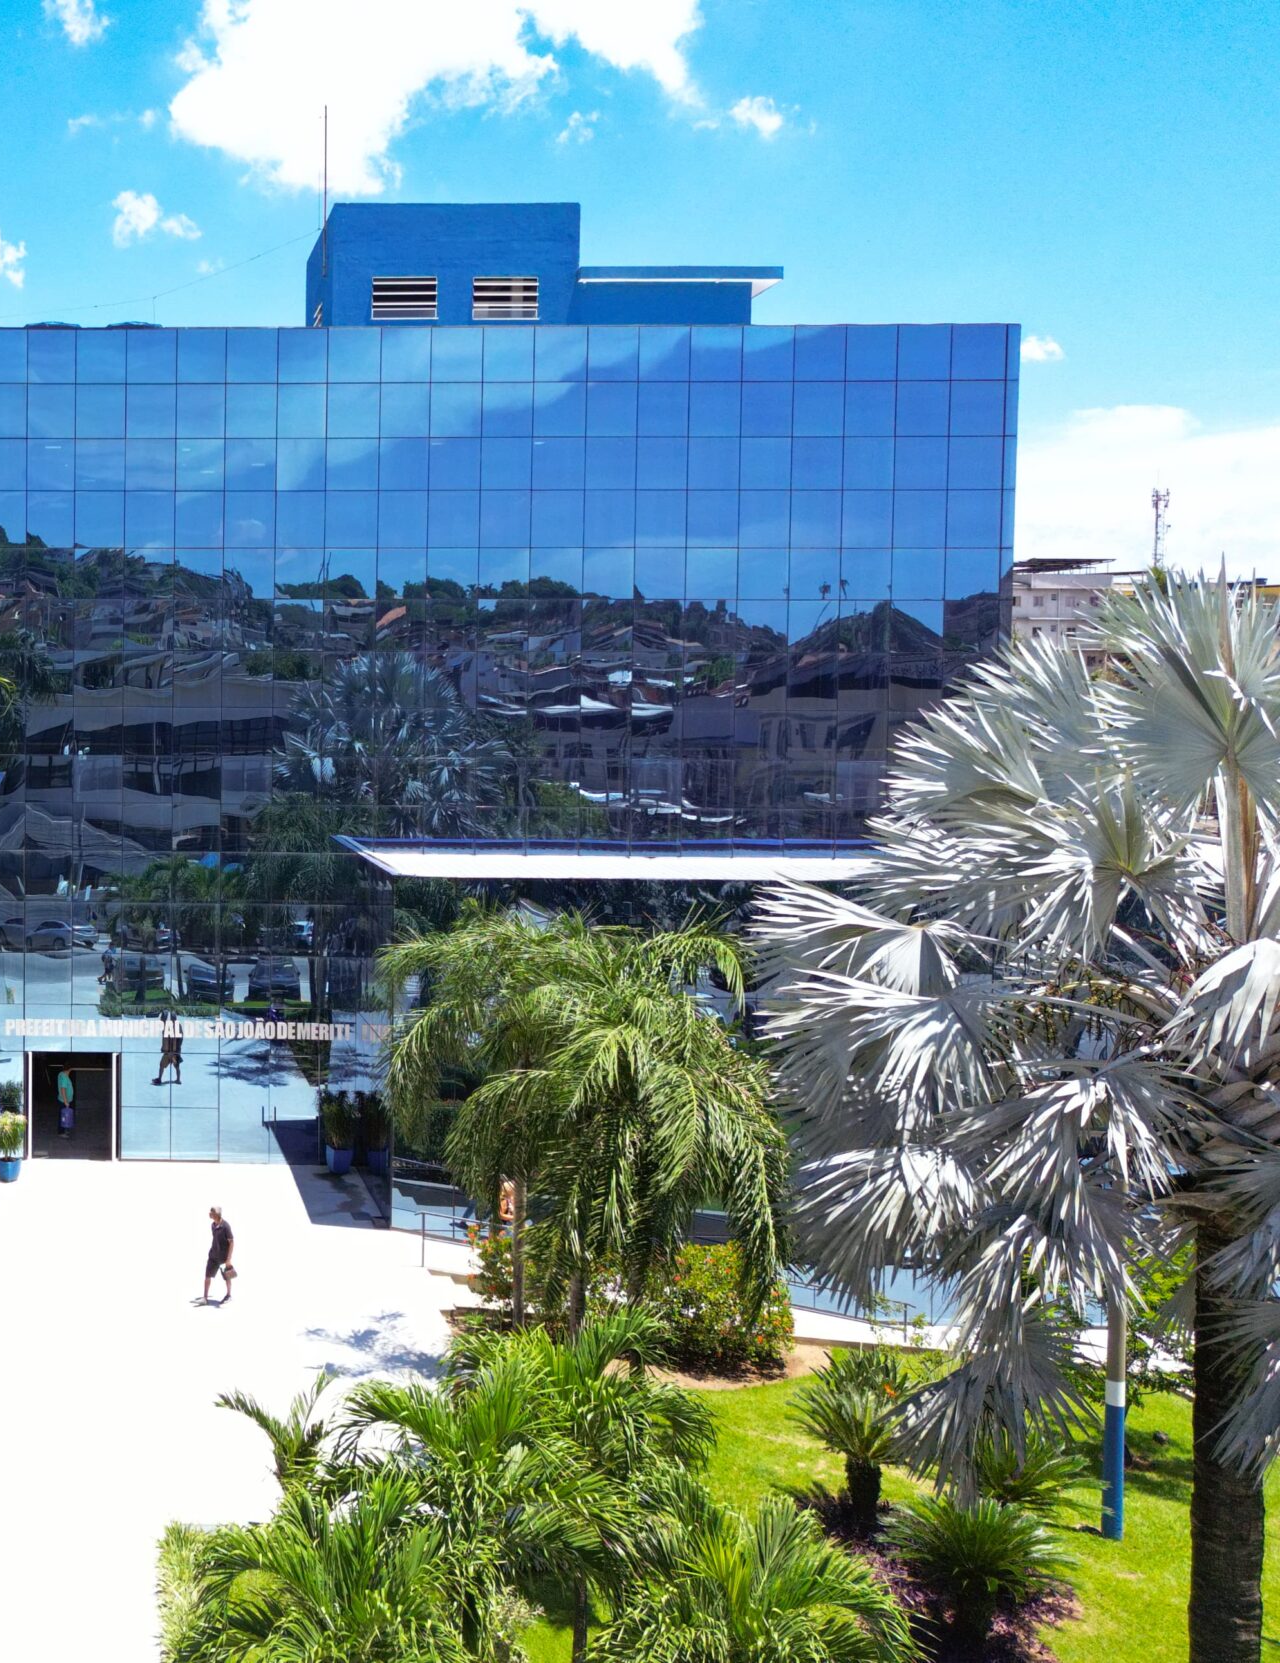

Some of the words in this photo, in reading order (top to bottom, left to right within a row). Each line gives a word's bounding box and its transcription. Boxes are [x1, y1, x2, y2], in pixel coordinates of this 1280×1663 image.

[5, 1018, 96, 1037] PREFEITURA
[99, 1019, 183, 1038] MUNICIPAL
[184, 1020, 202, 1039] DE
[204, 1016, 236, 1039] SÃO
[236, 1017, 276, 1040] JOÃO
[276, 1021, 296, 1040] DE
[296, 1022, 351, 1041] MERITI
